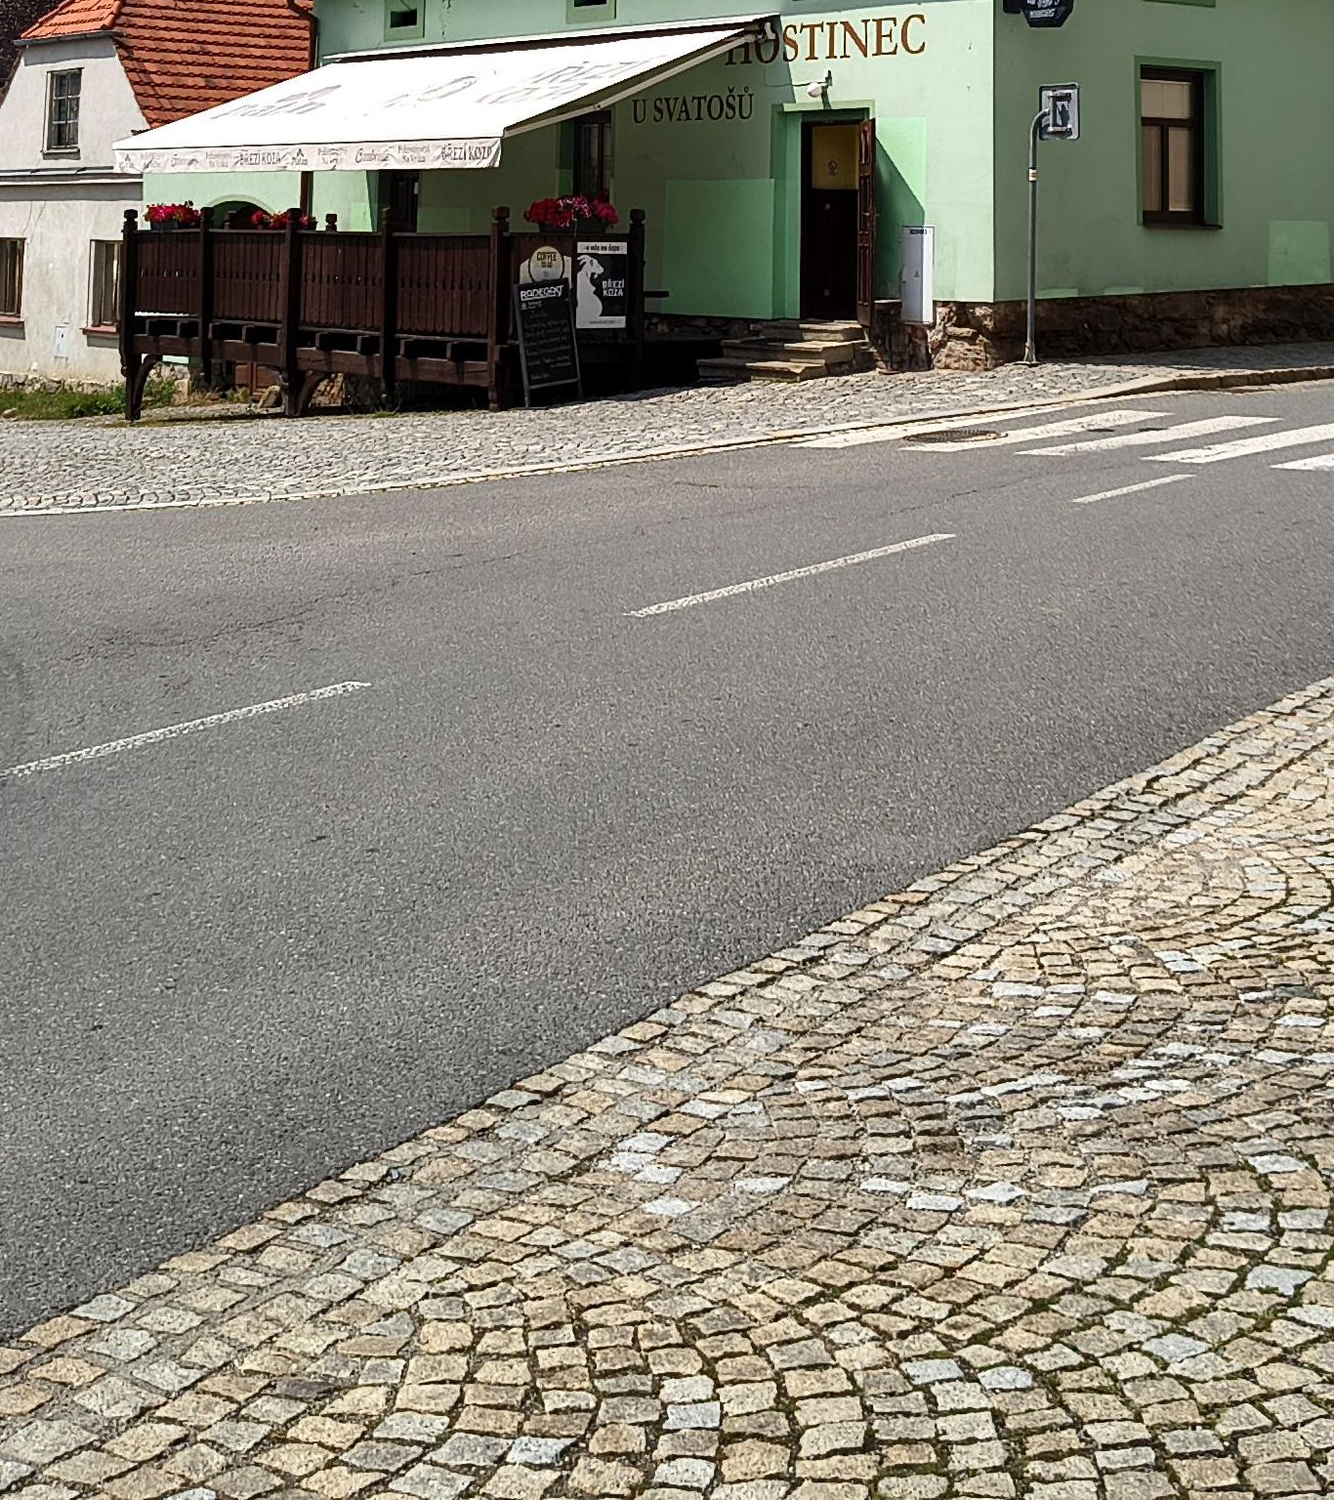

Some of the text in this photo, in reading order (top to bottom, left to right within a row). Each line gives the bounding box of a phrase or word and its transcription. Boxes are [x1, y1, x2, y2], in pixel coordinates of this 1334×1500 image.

[632, 86, 754, 124] U SVATOŠŮ
[602, 288, 624, 297] KOZA
